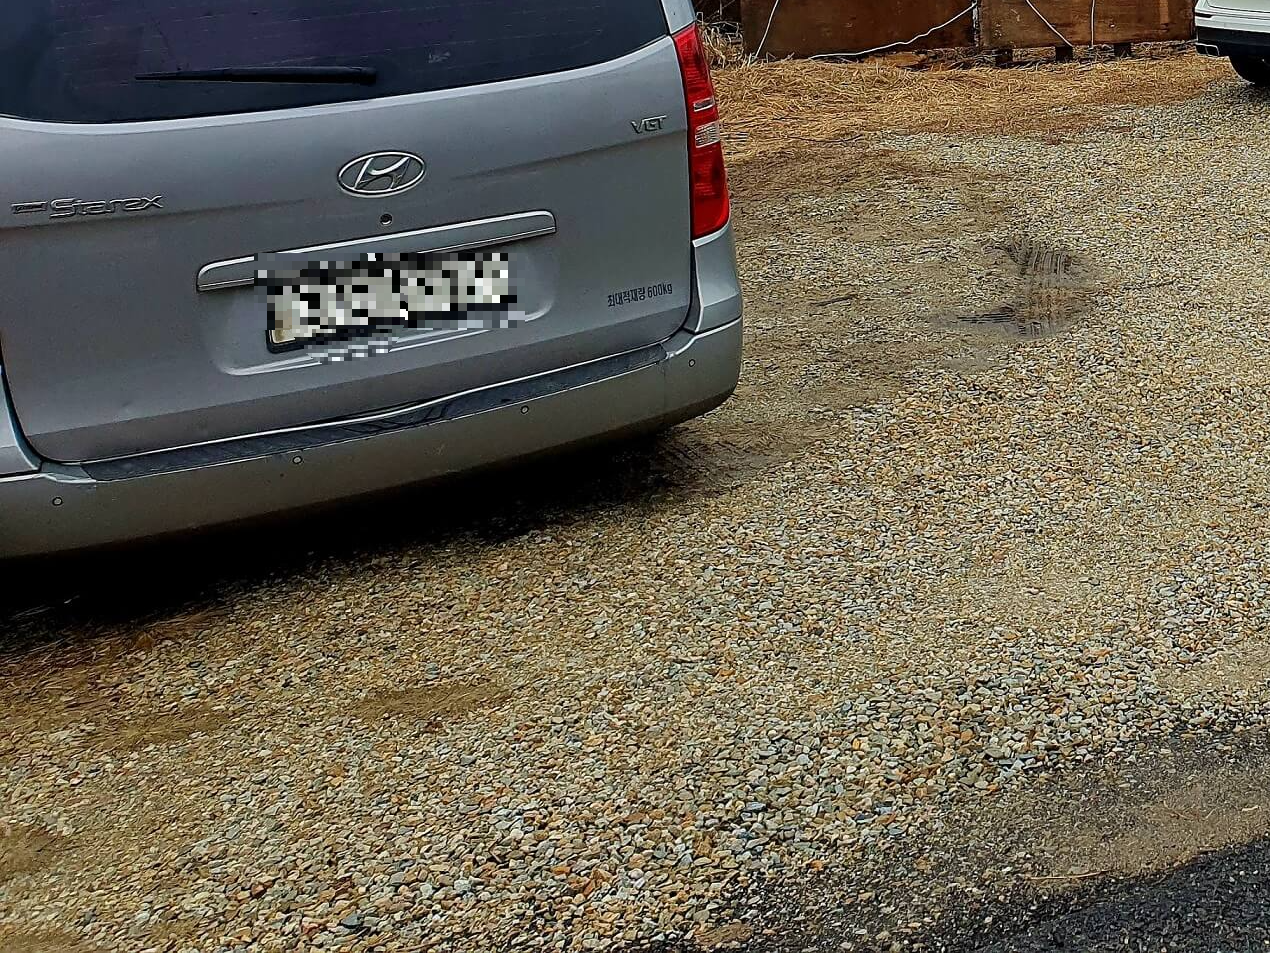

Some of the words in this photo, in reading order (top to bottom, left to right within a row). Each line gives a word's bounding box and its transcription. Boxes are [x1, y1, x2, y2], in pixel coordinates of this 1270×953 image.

[631, 115, 667, 134] VGT
[50, 196, 164, 219] Starex
[607, 286, 646, 307] 최대적재량
